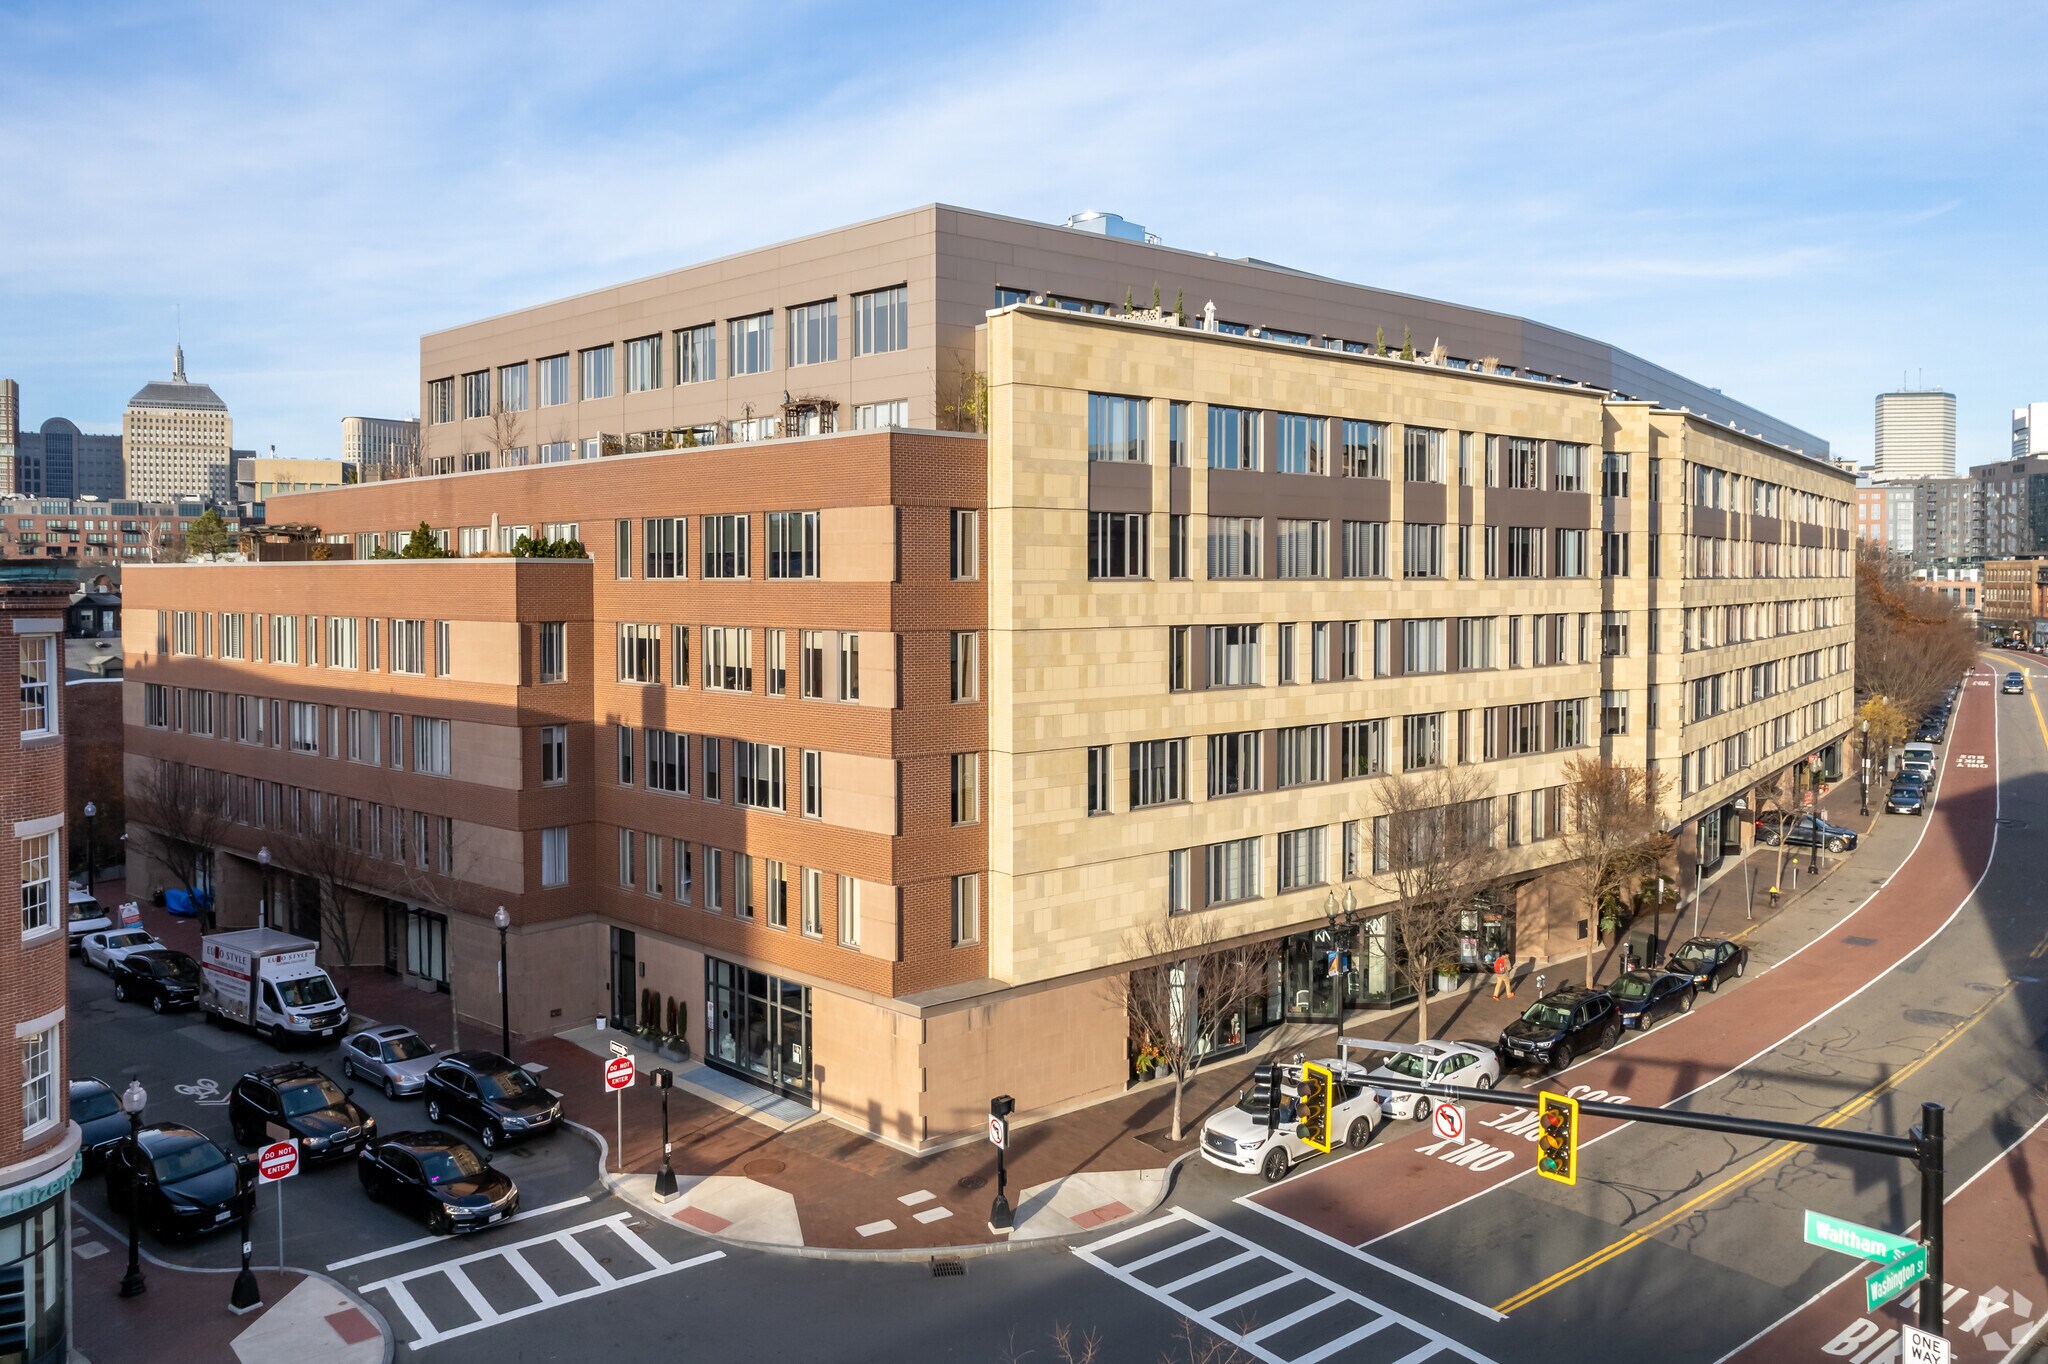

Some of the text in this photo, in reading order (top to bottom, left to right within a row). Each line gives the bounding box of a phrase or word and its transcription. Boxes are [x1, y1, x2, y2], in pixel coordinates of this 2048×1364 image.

[206, 945, 247, 965] EUO STYLE
[267, 955, 287, 964] EUO
[288, 952, 309, 960] STYLE
[612, 1076, 628, 1084] ENTER
[264, 1146, 293, 1160] DO NOT
[1415, 1137, 1516, 1172] ONLY
[267, 1163, 290, 1175] ENTER
[1816, 1220, 1906, 1260] Waltham S
[1870, 1260, 1924, 1301] Washington St
[1912, 1333, 1942, 1352] ONE
[1912, 1345, 1942, 1364] WAY
